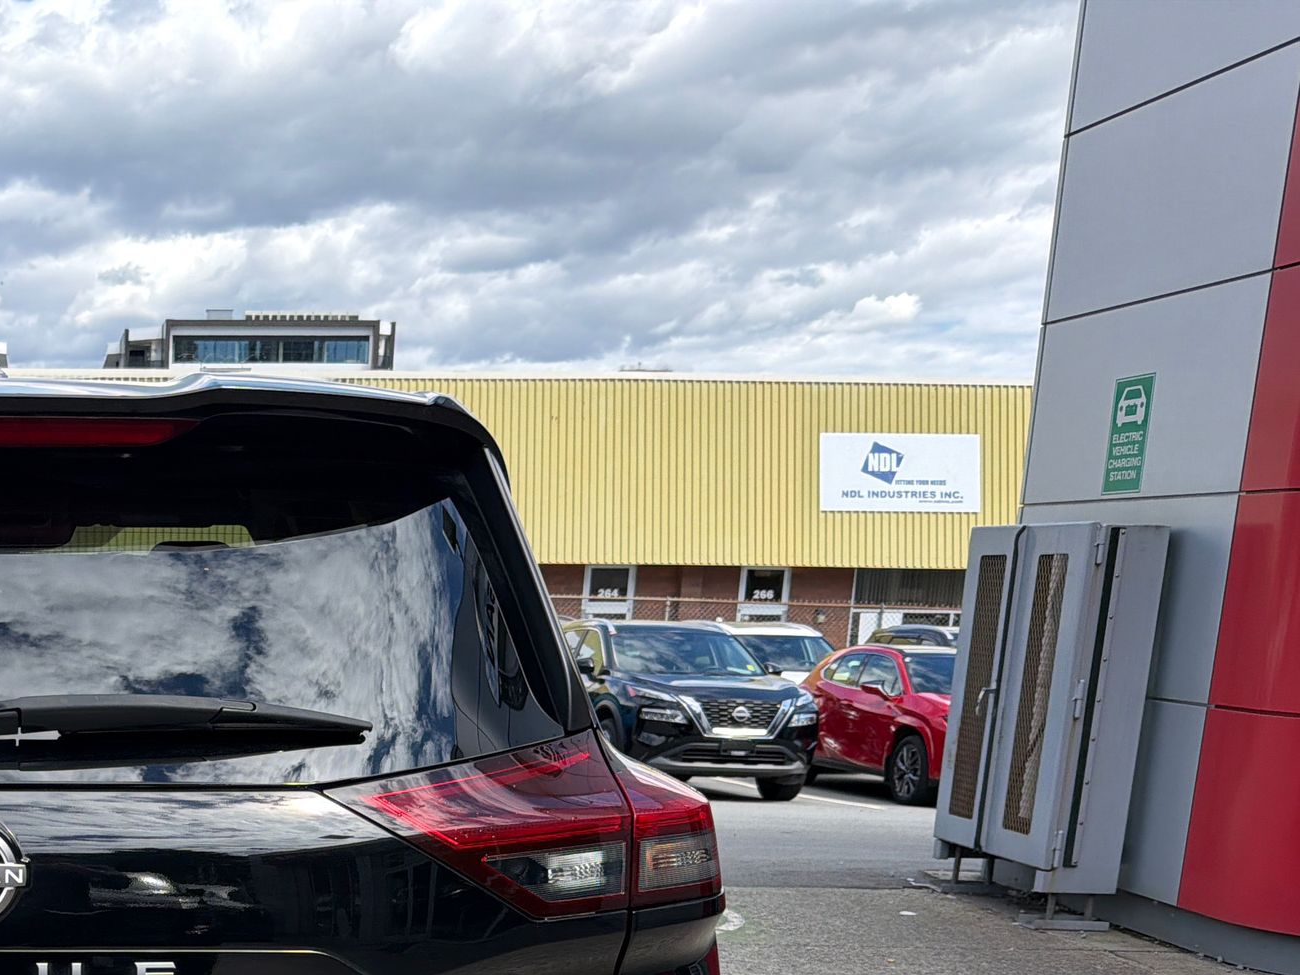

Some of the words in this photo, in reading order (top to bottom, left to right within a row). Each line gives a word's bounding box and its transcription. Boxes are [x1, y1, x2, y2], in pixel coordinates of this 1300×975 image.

[1112, 431, 1144, 443] ELECTRIC
[1112, 444, 1139, 456] VEHICLE
[867, 452, 900, 473] NDL
[1108, 456, 1142, 469] CHARGING
[1109, 469, 1137, 481] STATION
[841, 490, 865, 499] NDL
[867, 490, 937, 499] INDUSTRIES
[940, 490, 964, 499] INC.
[597, 588, 619, 599] 264
[752, 589, 774, 600] 266
